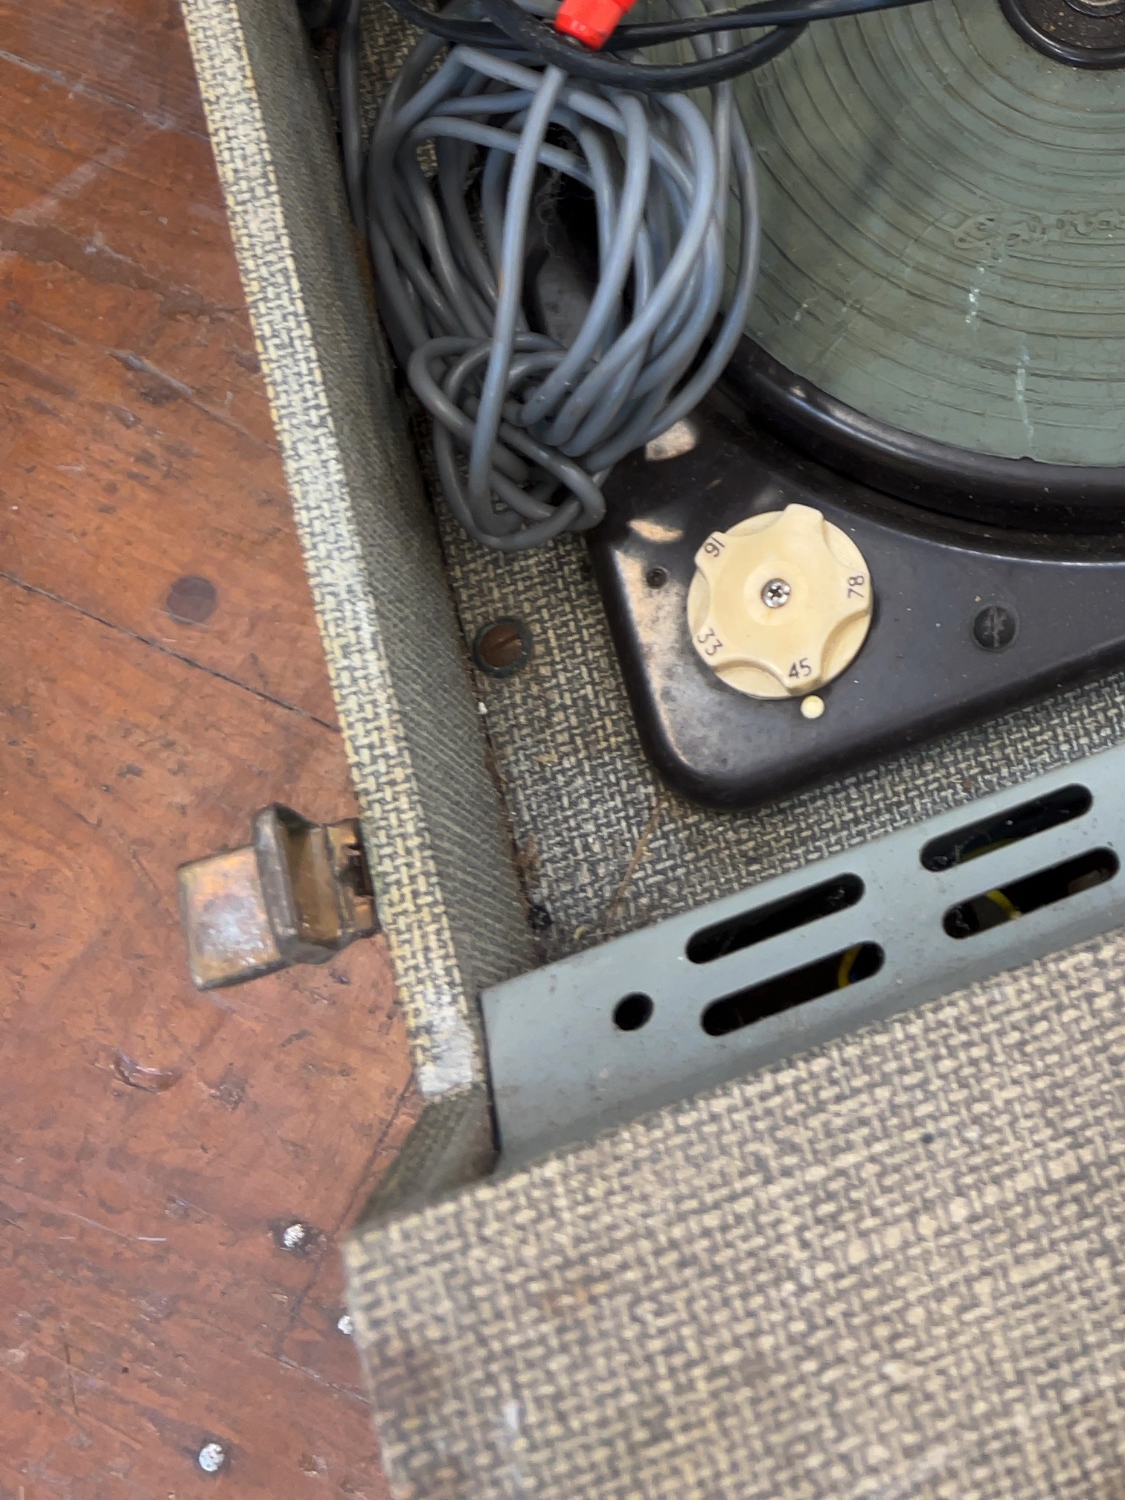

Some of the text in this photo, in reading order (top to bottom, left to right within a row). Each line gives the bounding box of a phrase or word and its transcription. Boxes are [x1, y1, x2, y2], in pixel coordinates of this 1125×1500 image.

[704, 536, 726, 558] 16
[847, 574, 866, 599] 78
[697, 627, 723, 657] 33
[788, 657, 812, 679] 45
